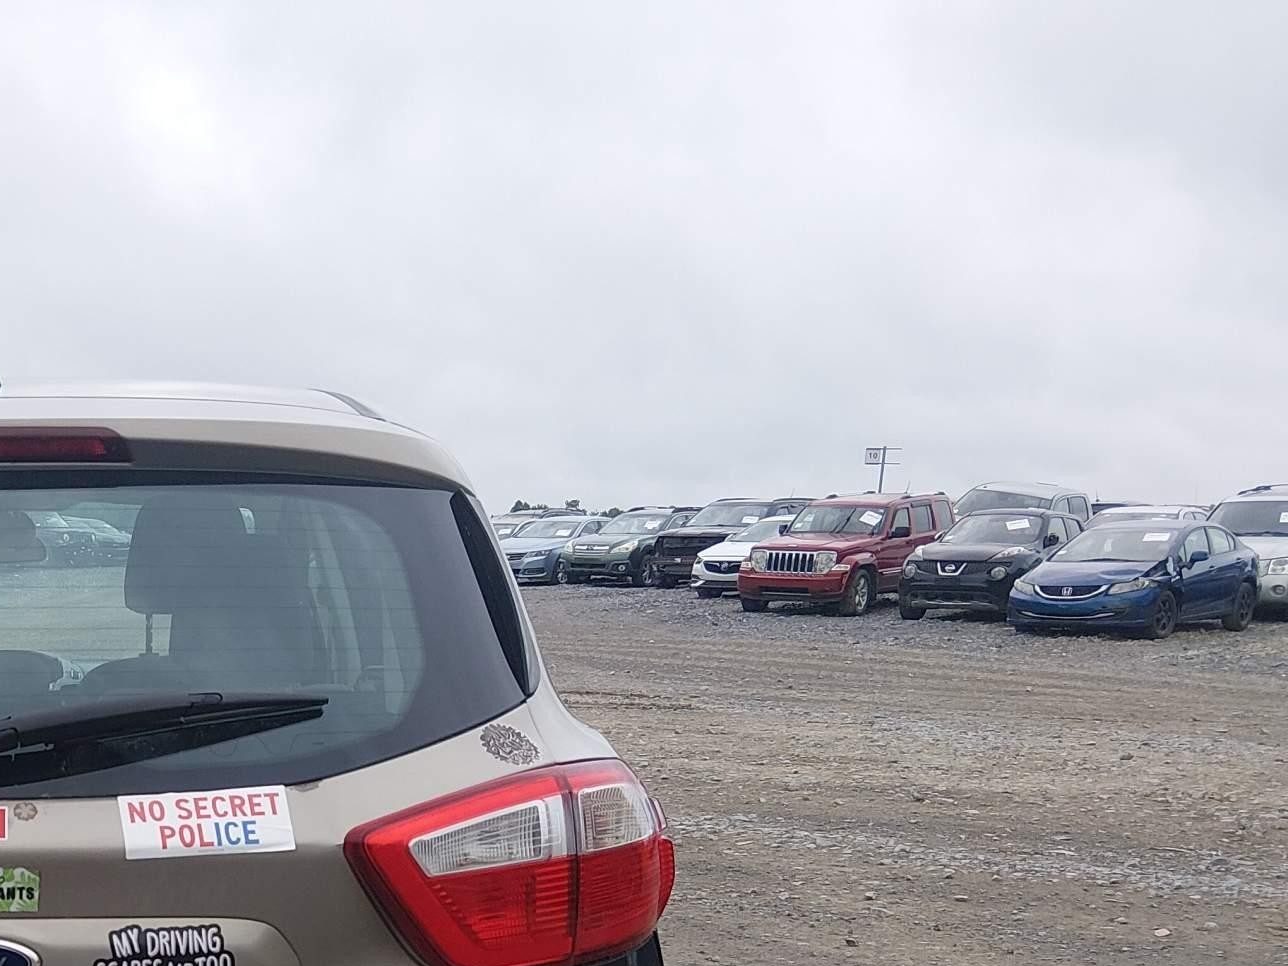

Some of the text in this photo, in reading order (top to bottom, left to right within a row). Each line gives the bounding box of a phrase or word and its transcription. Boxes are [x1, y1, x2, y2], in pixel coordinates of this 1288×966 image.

[128, 793, 279, 823] NO SECRET
[160, 820, 260, 849] POLICE
[112, 927, 222, 958] MY DRIVING
